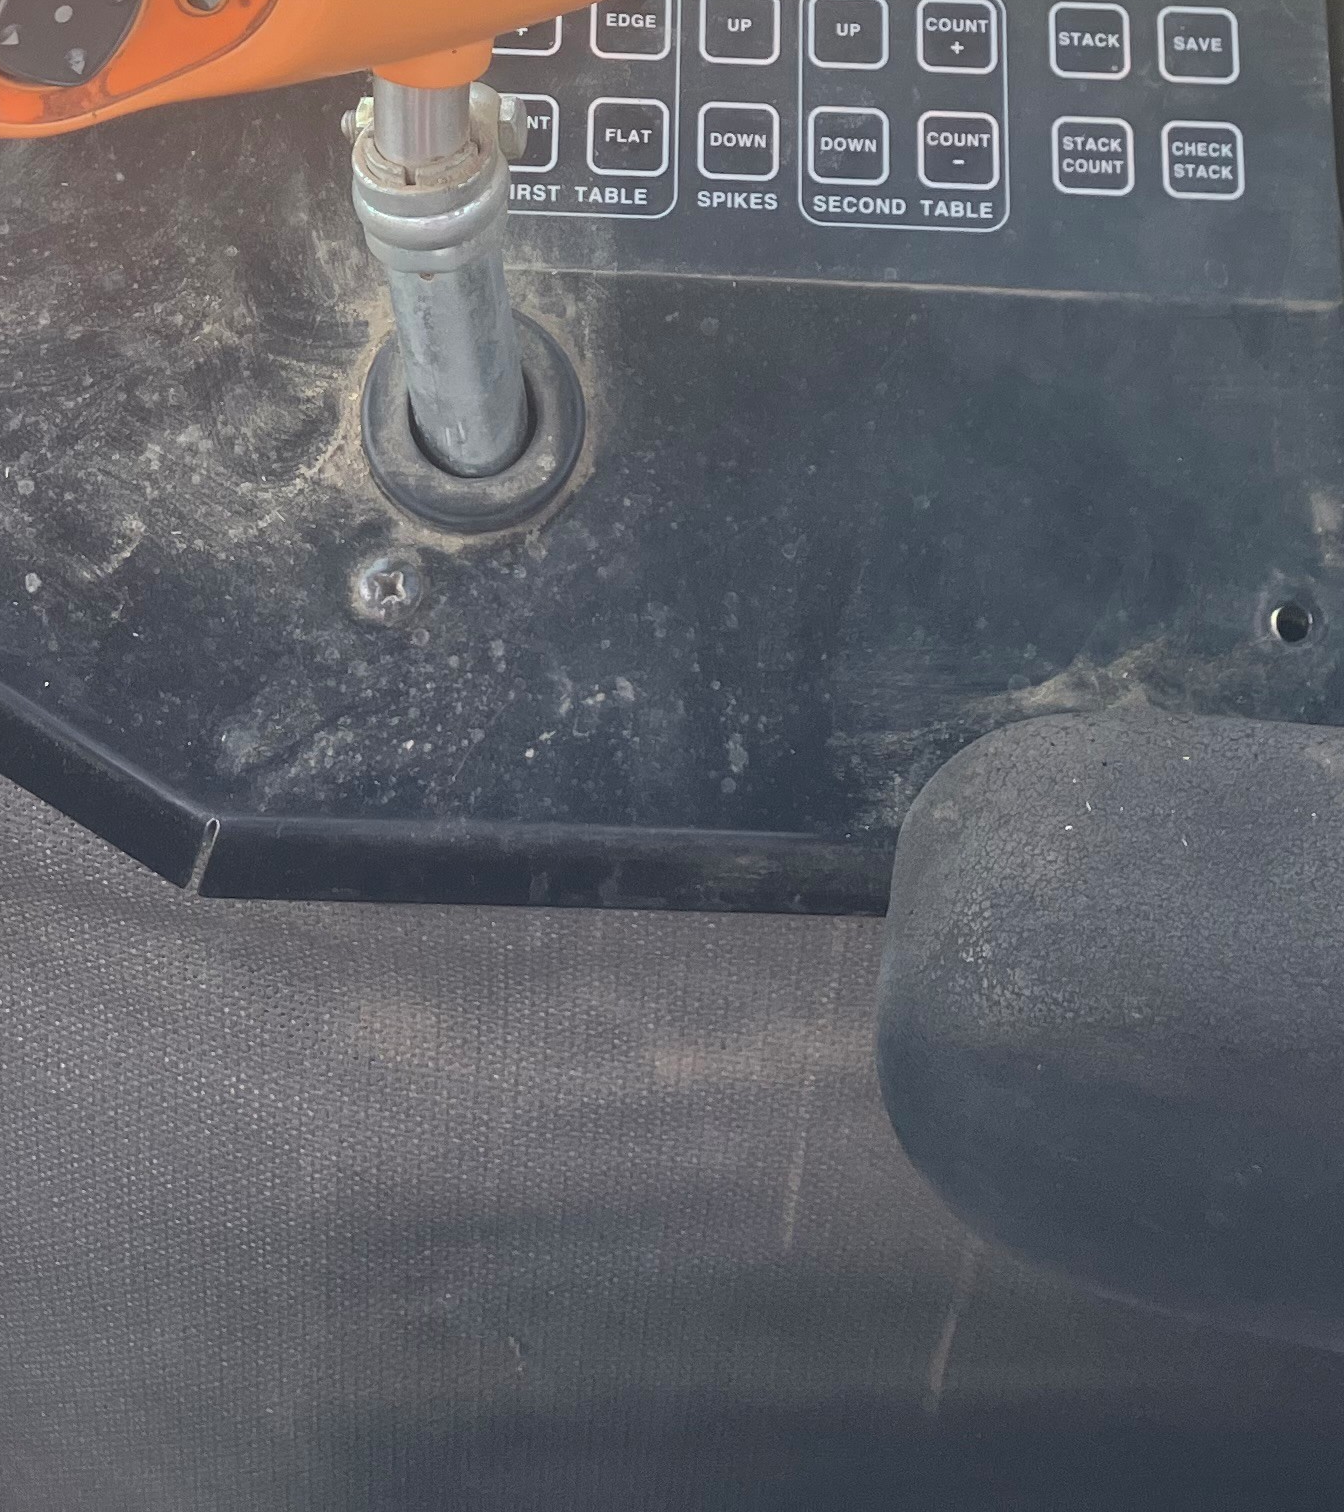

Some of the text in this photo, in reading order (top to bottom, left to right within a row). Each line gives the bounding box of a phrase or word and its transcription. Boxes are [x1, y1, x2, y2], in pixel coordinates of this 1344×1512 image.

[606, 13, 656, 28] EDGE
[728, 19, 751, 31] UP
[926, 18, 988, 32] COUNT
[837, 23, 860, 36] UP
[1059, 32, 1119, 47] STACK
[1174, 36, 1222, 52] SAVE
[606, 129, 651, 143] FLAT
[710, 133, 766, 148] DOWN
[927, 132, 990, 147] COUNT
[821, 137, 876, 152] DOWN
[1063, 136, 1121, 152] STACK
[1172, 142, 1232, 157] CHECK
[1063, 158, 1124, 173] COUNT
[1174, 164, 1233, 179] STACK
[510, 184, 647, 204] IRST TABLE
[698, 191, 777, 209] SPIKES
[814, 196, 993, 218] SECOND TABLE
